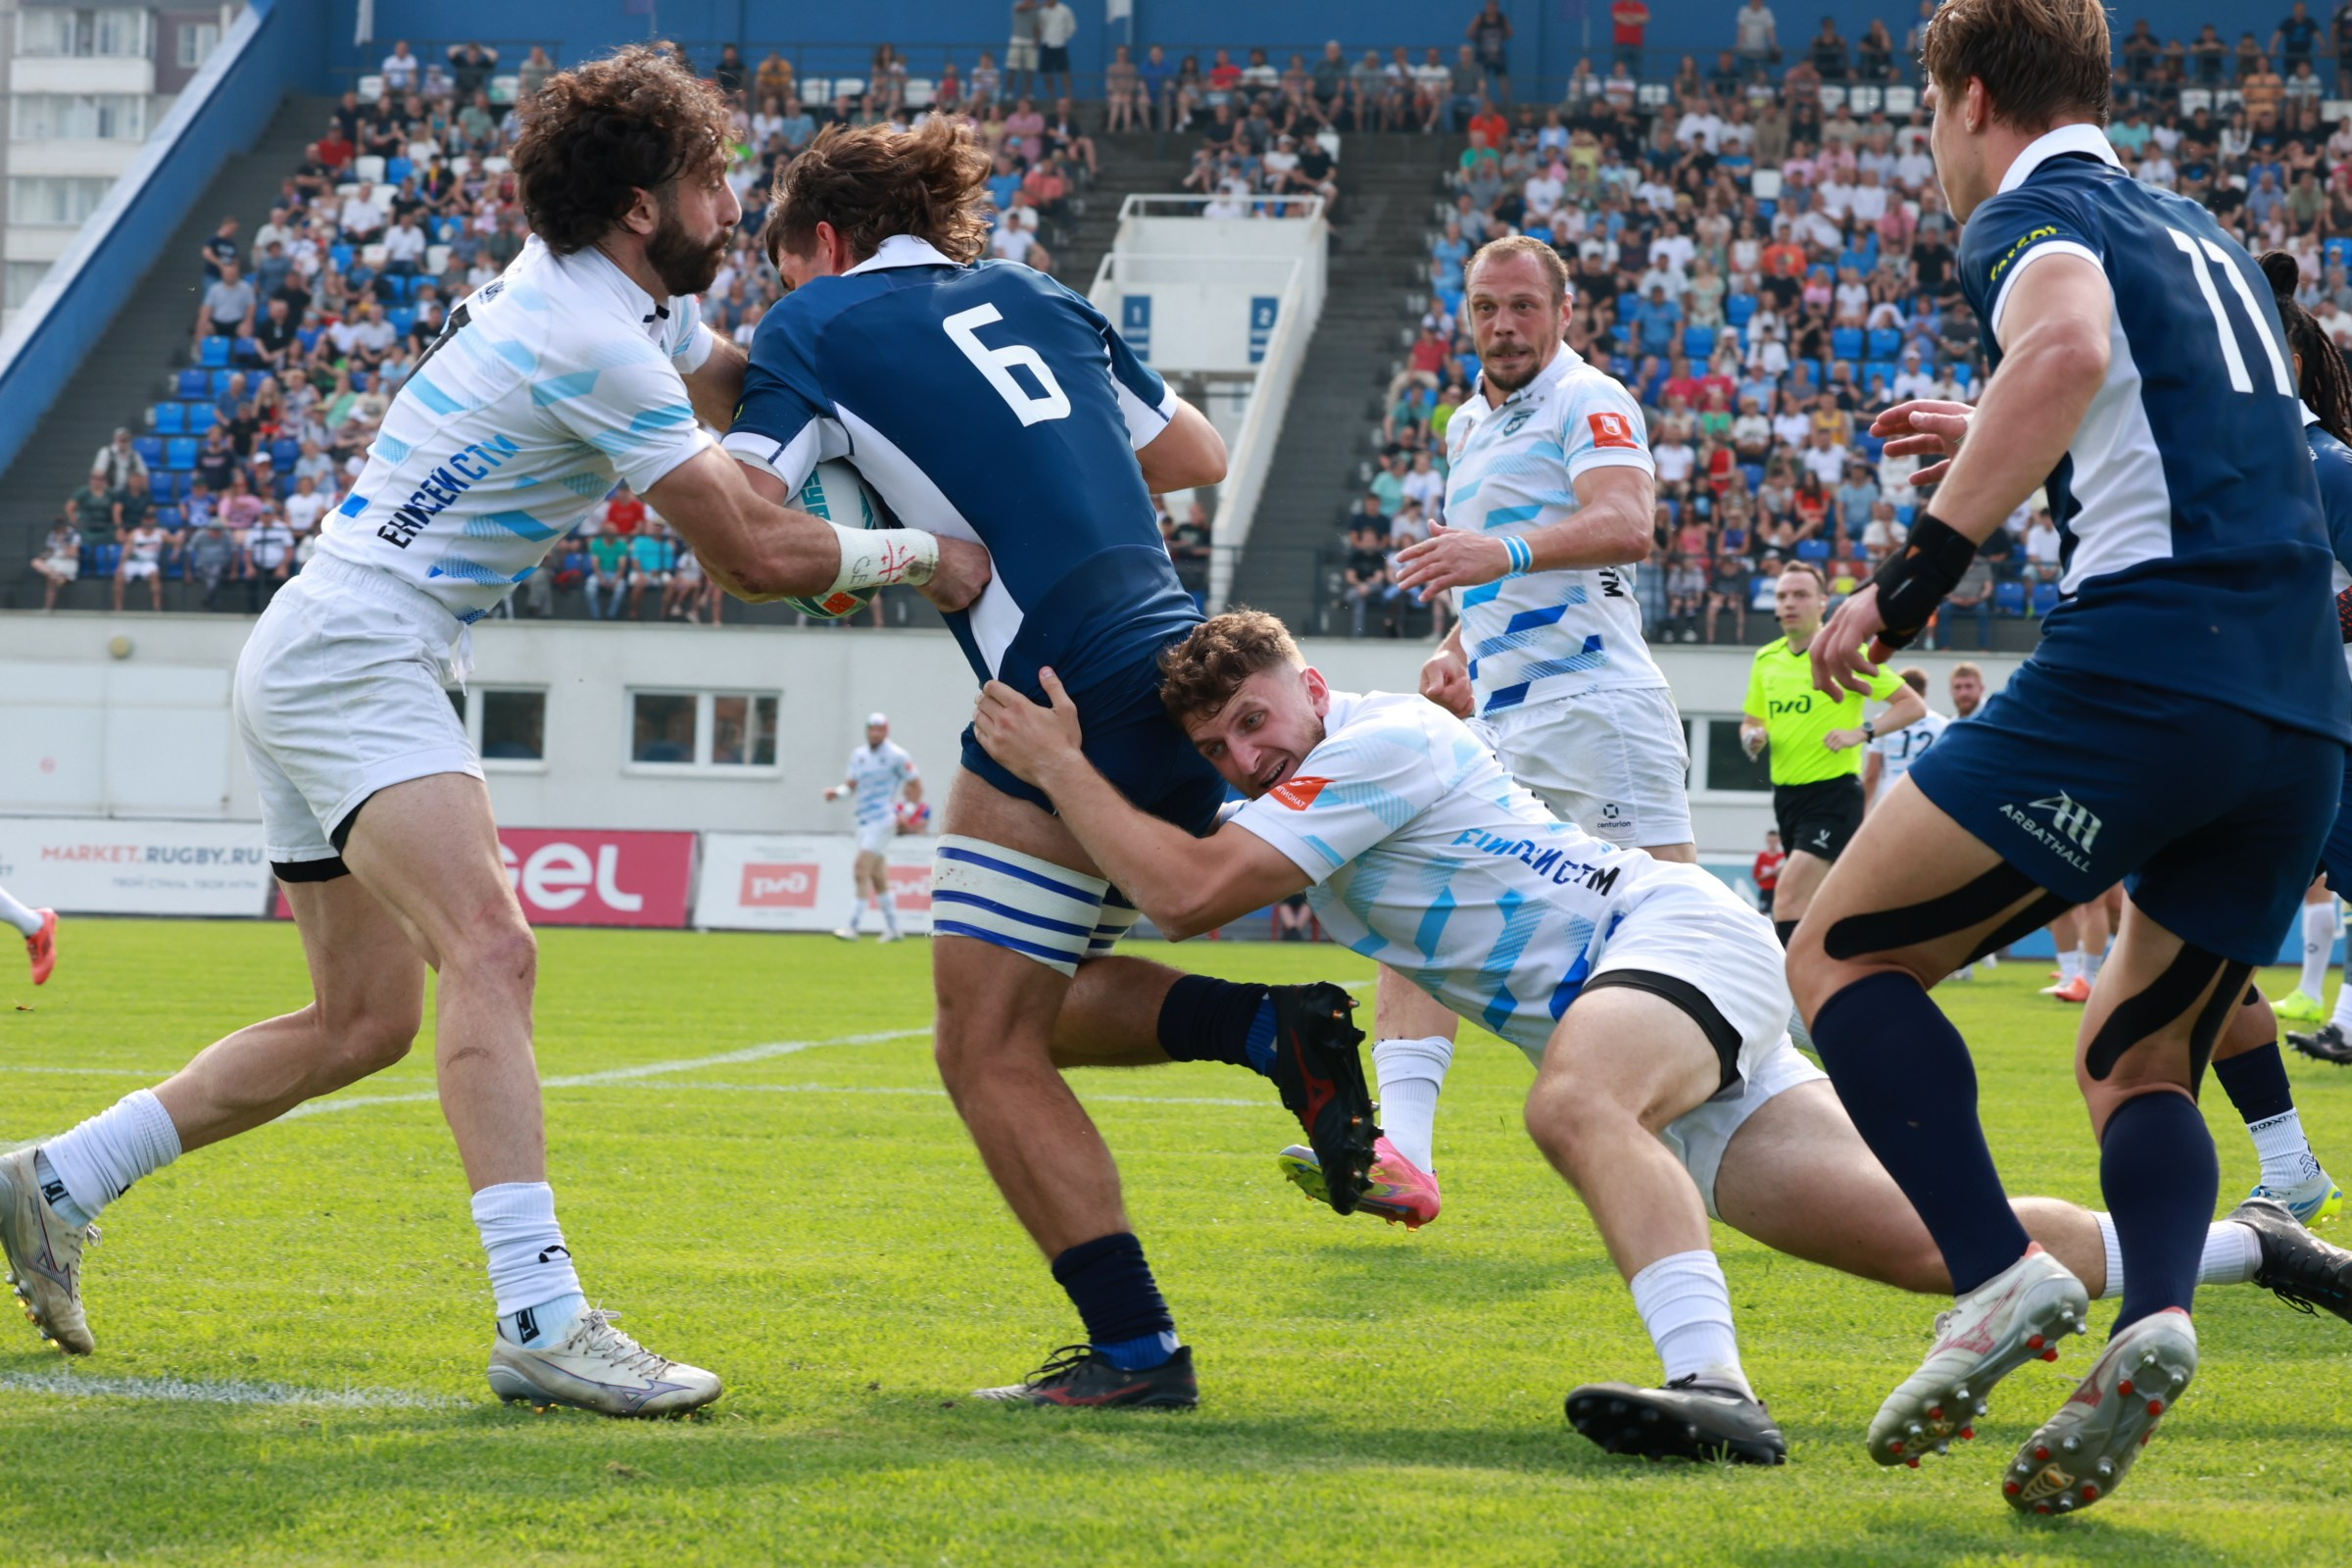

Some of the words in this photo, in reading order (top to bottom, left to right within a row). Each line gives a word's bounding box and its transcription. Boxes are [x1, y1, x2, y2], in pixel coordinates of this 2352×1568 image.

[1257, 307, 1273, 326] 2
[2166, 226, 2294, 399] 11
[942, 302, 1072, 428] 6
[377, 466, 471, 550] ЕНИСЕЙ
[449, 433, 523, 481] СТМ
[1598, 565, 1624, 597] ТМ
[1900, 730, 1934, 760] 12
[40, 844, 263, 866] MARKET.RUGBY.RU
[1998, 803, 2092, 873] ARBATHALL
